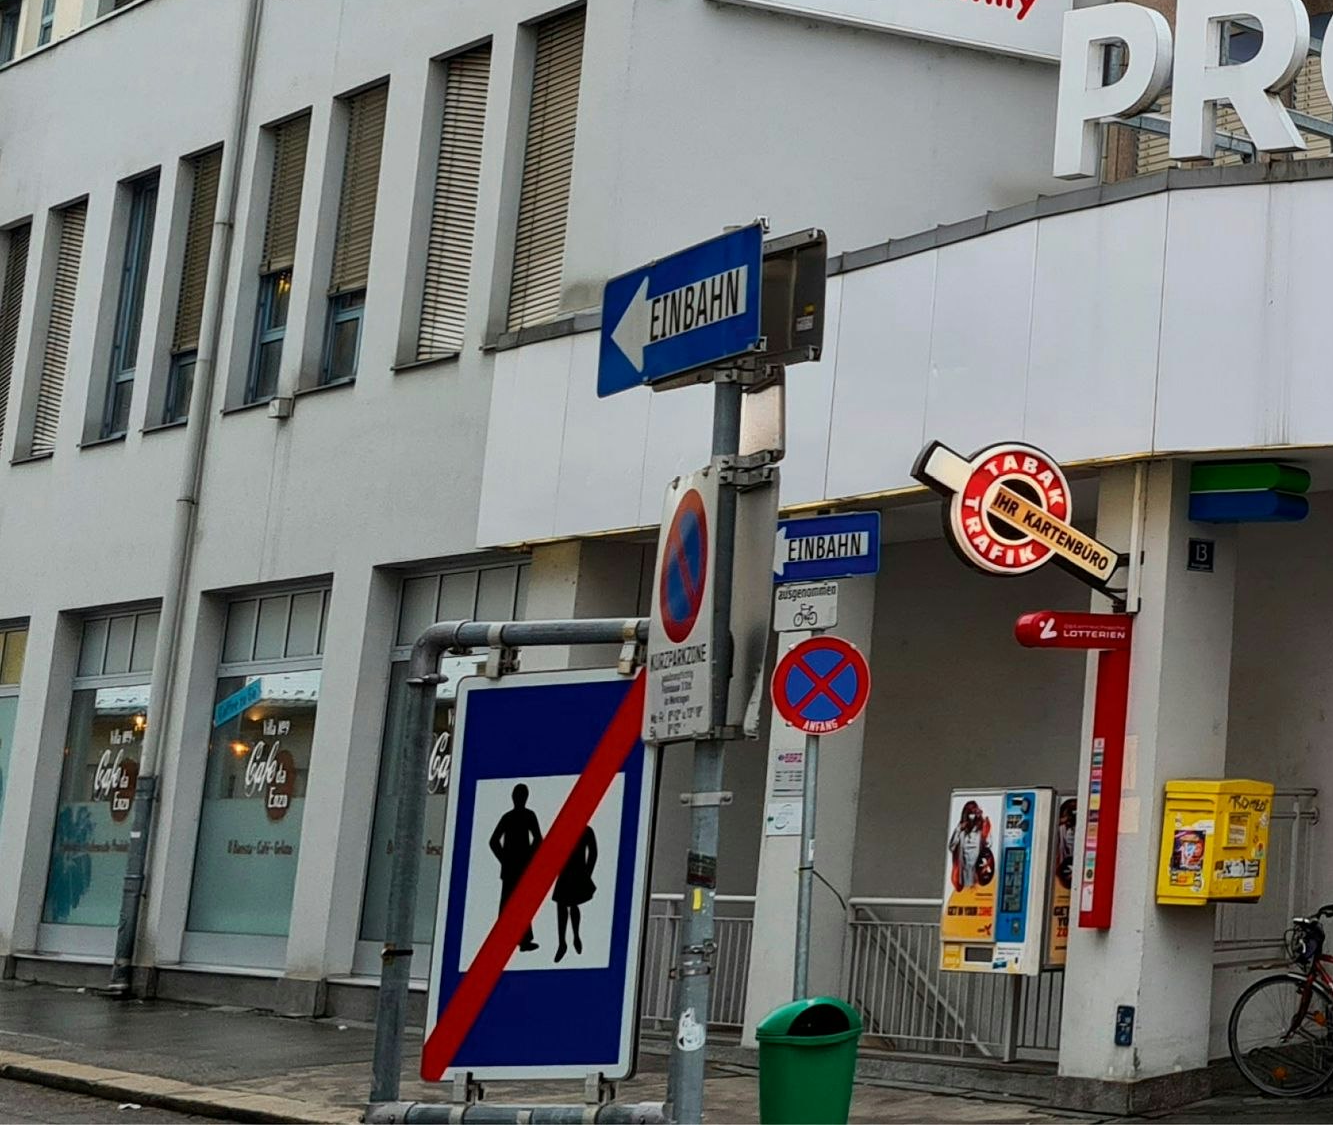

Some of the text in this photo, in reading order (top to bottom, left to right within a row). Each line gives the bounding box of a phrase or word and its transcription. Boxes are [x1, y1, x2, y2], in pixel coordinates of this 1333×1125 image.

[649, 269, 741, 344] EINBAHN
[984, 454, 1064, 506] TABAK
[788, 532, 861, 562] EINBAHN
[964, 496, 1037, 565] TRAFIK
[993, 492, 1109, 572] IHR KARTENBÜRO
[778, 585, 837, 602] ausgenommen
[1063, 630, 1126, 639] LOTTERIEN
[802, 718, 839, 732] ANFANG
[428, 731, 452, 795] Ca
[267, 786, 288, 808] Enzo
